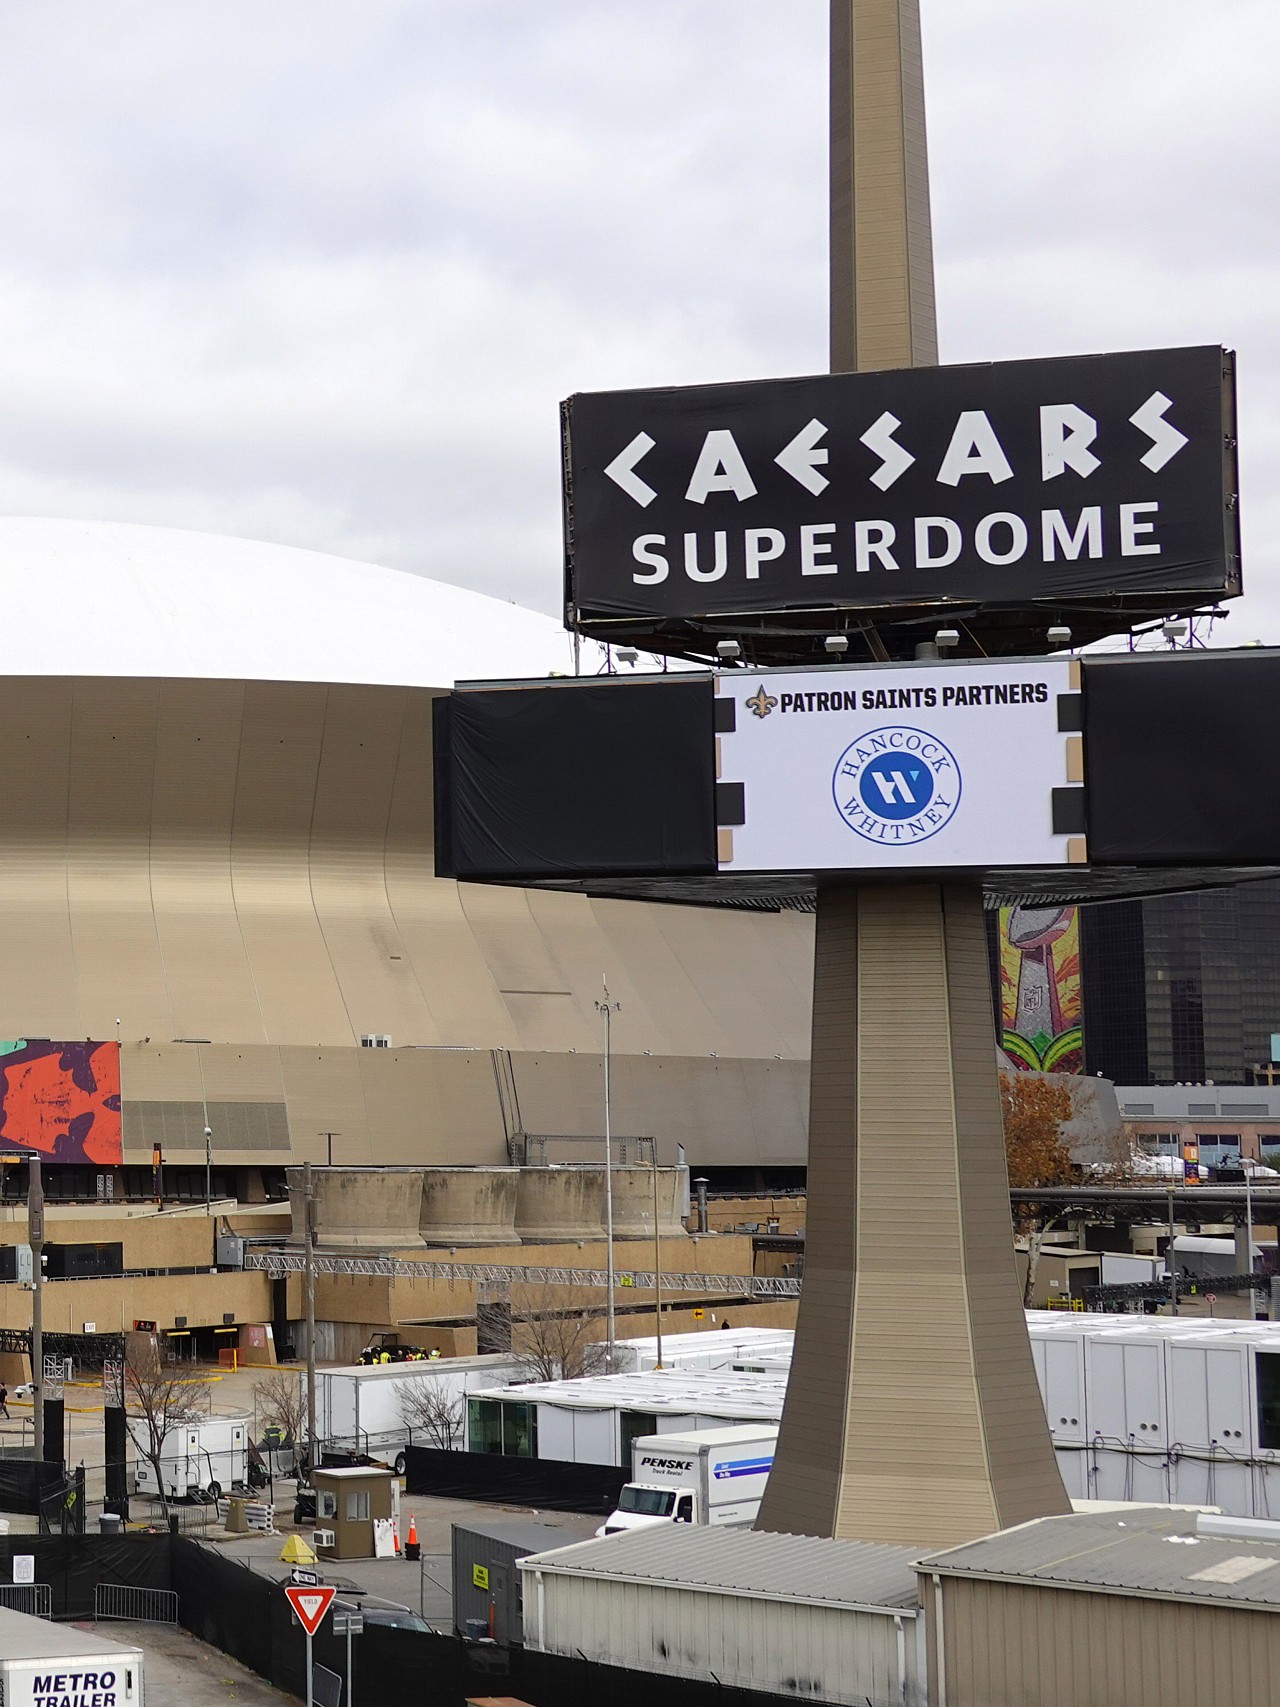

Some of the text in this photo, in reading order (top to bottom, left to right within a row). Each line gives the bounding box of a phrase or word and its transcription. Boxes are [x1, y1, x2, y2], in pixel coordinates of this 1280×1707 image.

[603, 391, 1189, 507] CAESARS
[632, 501, 1161, 585] SUPERDOME
[780, 683, 1048, 713] PATRON SAINTS PARTNERS
[841, 733, 952, 779] HANCOCK
[842, 793, 952, 840] WHITNEY
[641, 1457, 694, 1470] PENSKE
[33, 1671, 116, 1694] METRO
[34, 1692, 116, 1707] TRAILER
